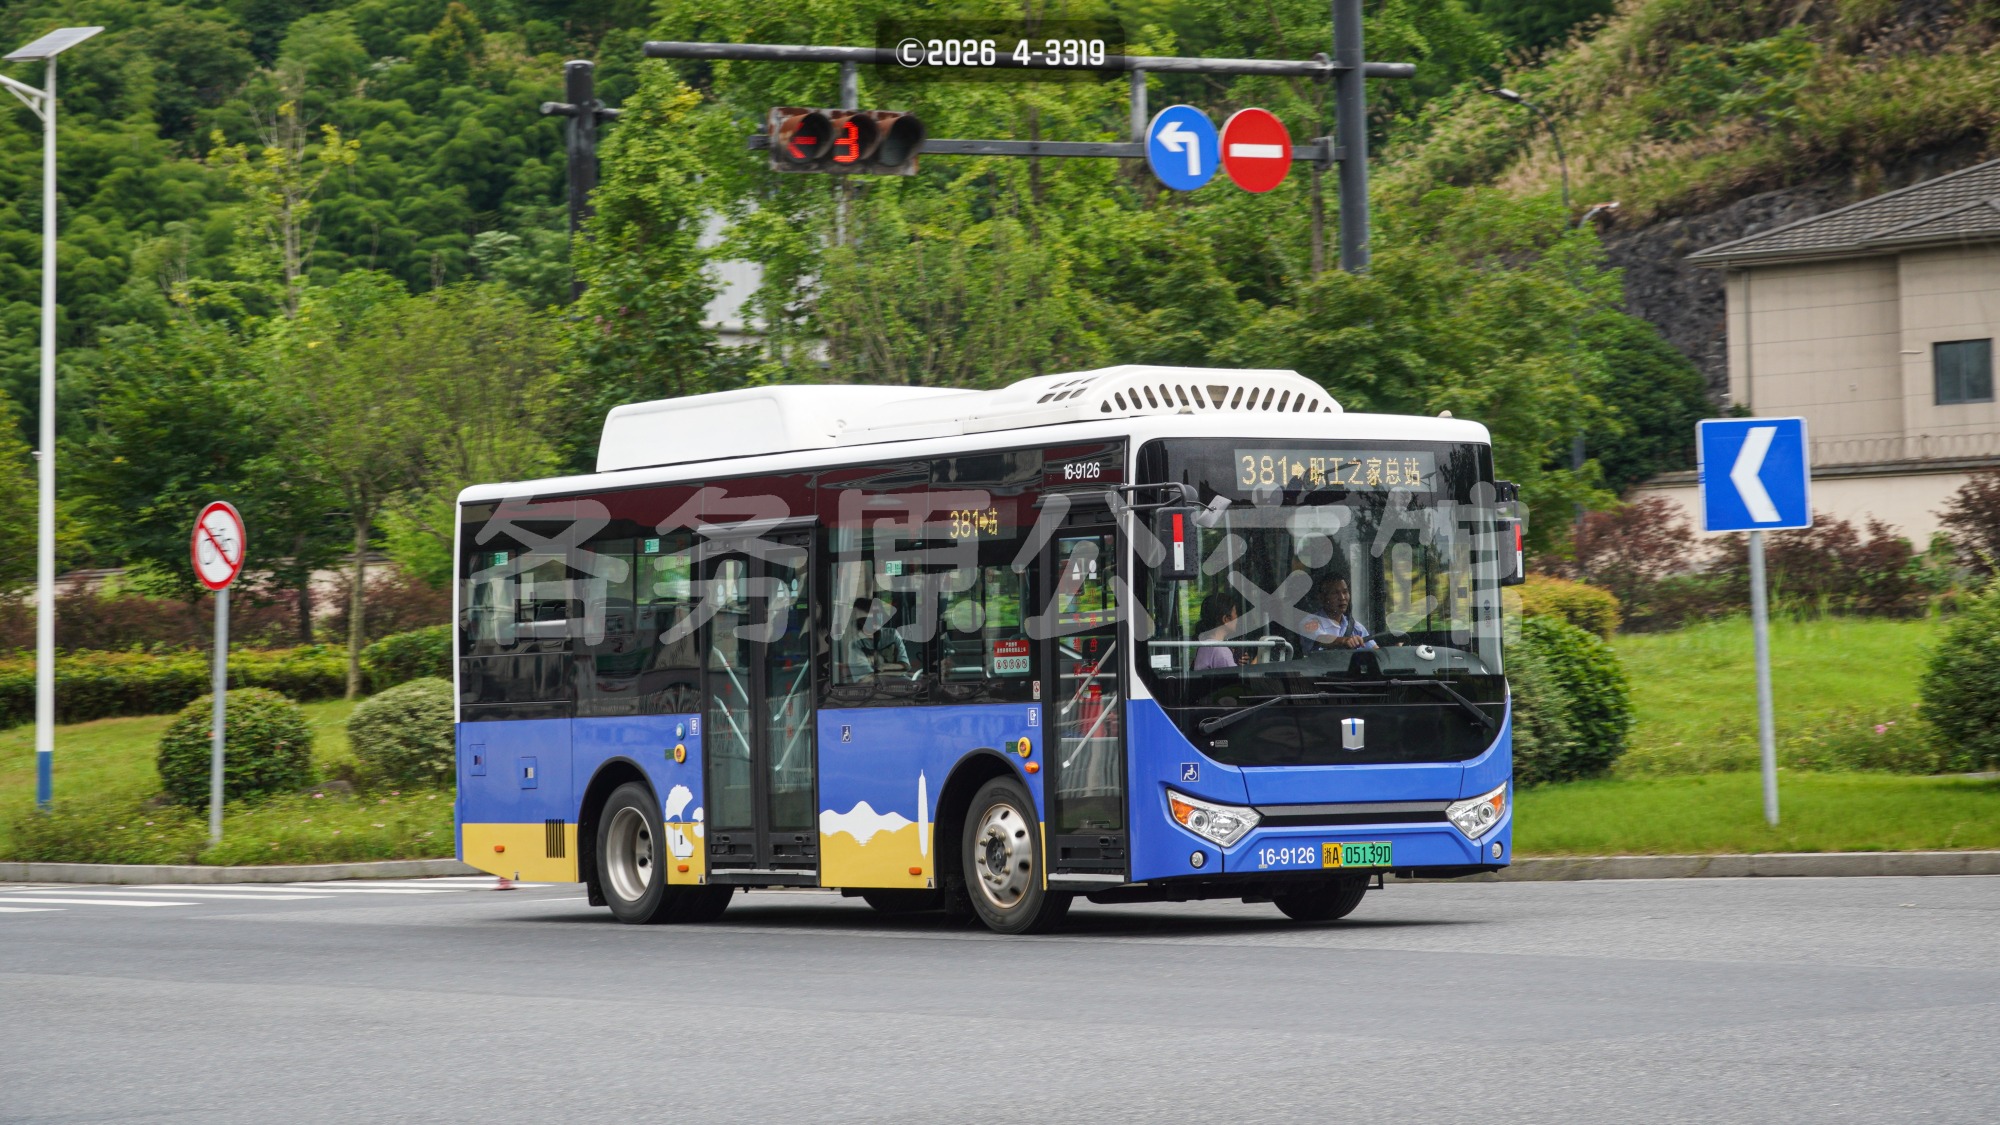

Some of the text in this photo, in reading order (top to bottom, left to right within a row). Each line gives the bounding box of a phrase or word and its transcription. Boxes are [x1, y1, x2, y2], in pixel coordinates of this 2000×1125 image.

[832, 121, 861, 163] 3
[1063, 461, 1101, 480] 16-9126
[1241, 455, 1422, 487] 381 职工之家总站
[950, 508, 979, 539] 381
[1258, 846, 1316, 866] 16-9126
